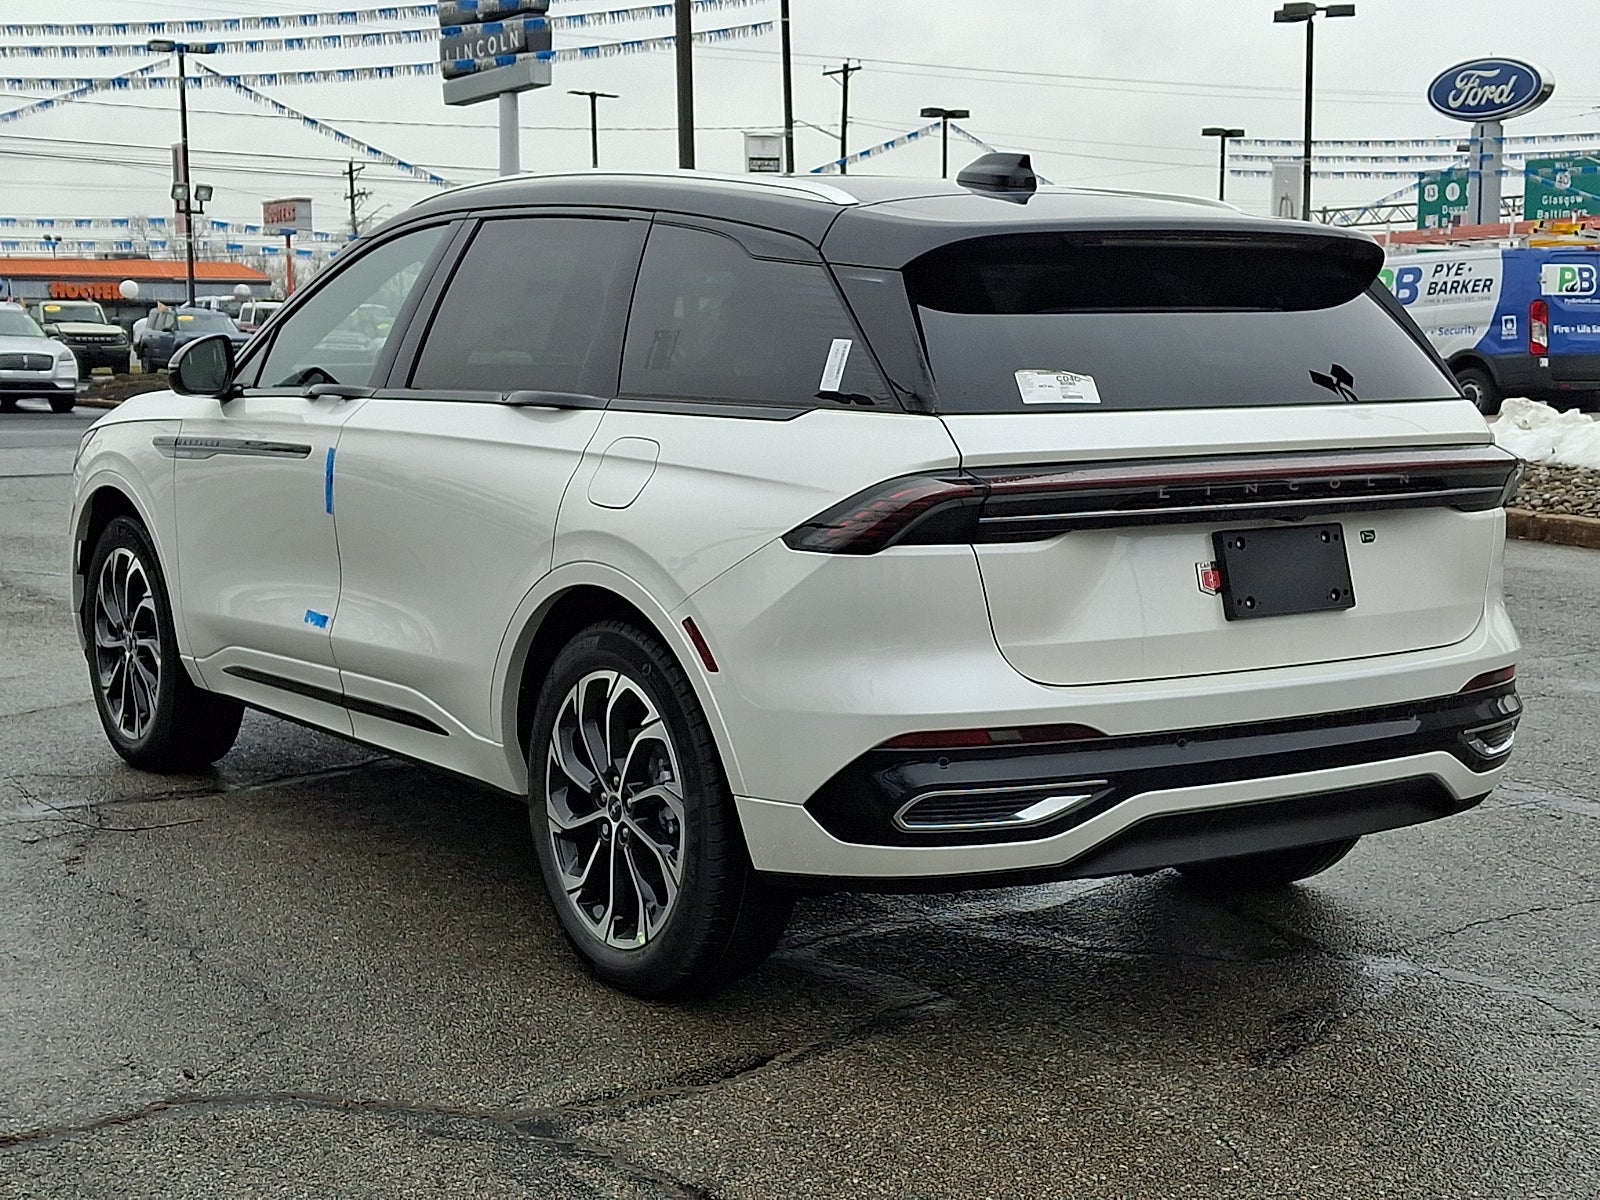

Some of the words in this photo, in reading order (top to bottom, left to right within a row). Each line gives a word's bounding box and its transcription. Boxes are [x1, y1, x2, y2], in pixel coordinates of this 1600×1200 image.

[446, 30, 519, 60] LINCOLN
[1448, 68, 1518, 108] Ford
[1557, 174, 1570, 185] 40
[1541, 195, 1584, 207] Glasgow
[1427, 278, 1494, 296] BARKER
[1438, 325, 1477, 337] Security
[1553, 324, 1570, 334] Fire
[1159, 475, 1410, 498] LINCOLN
